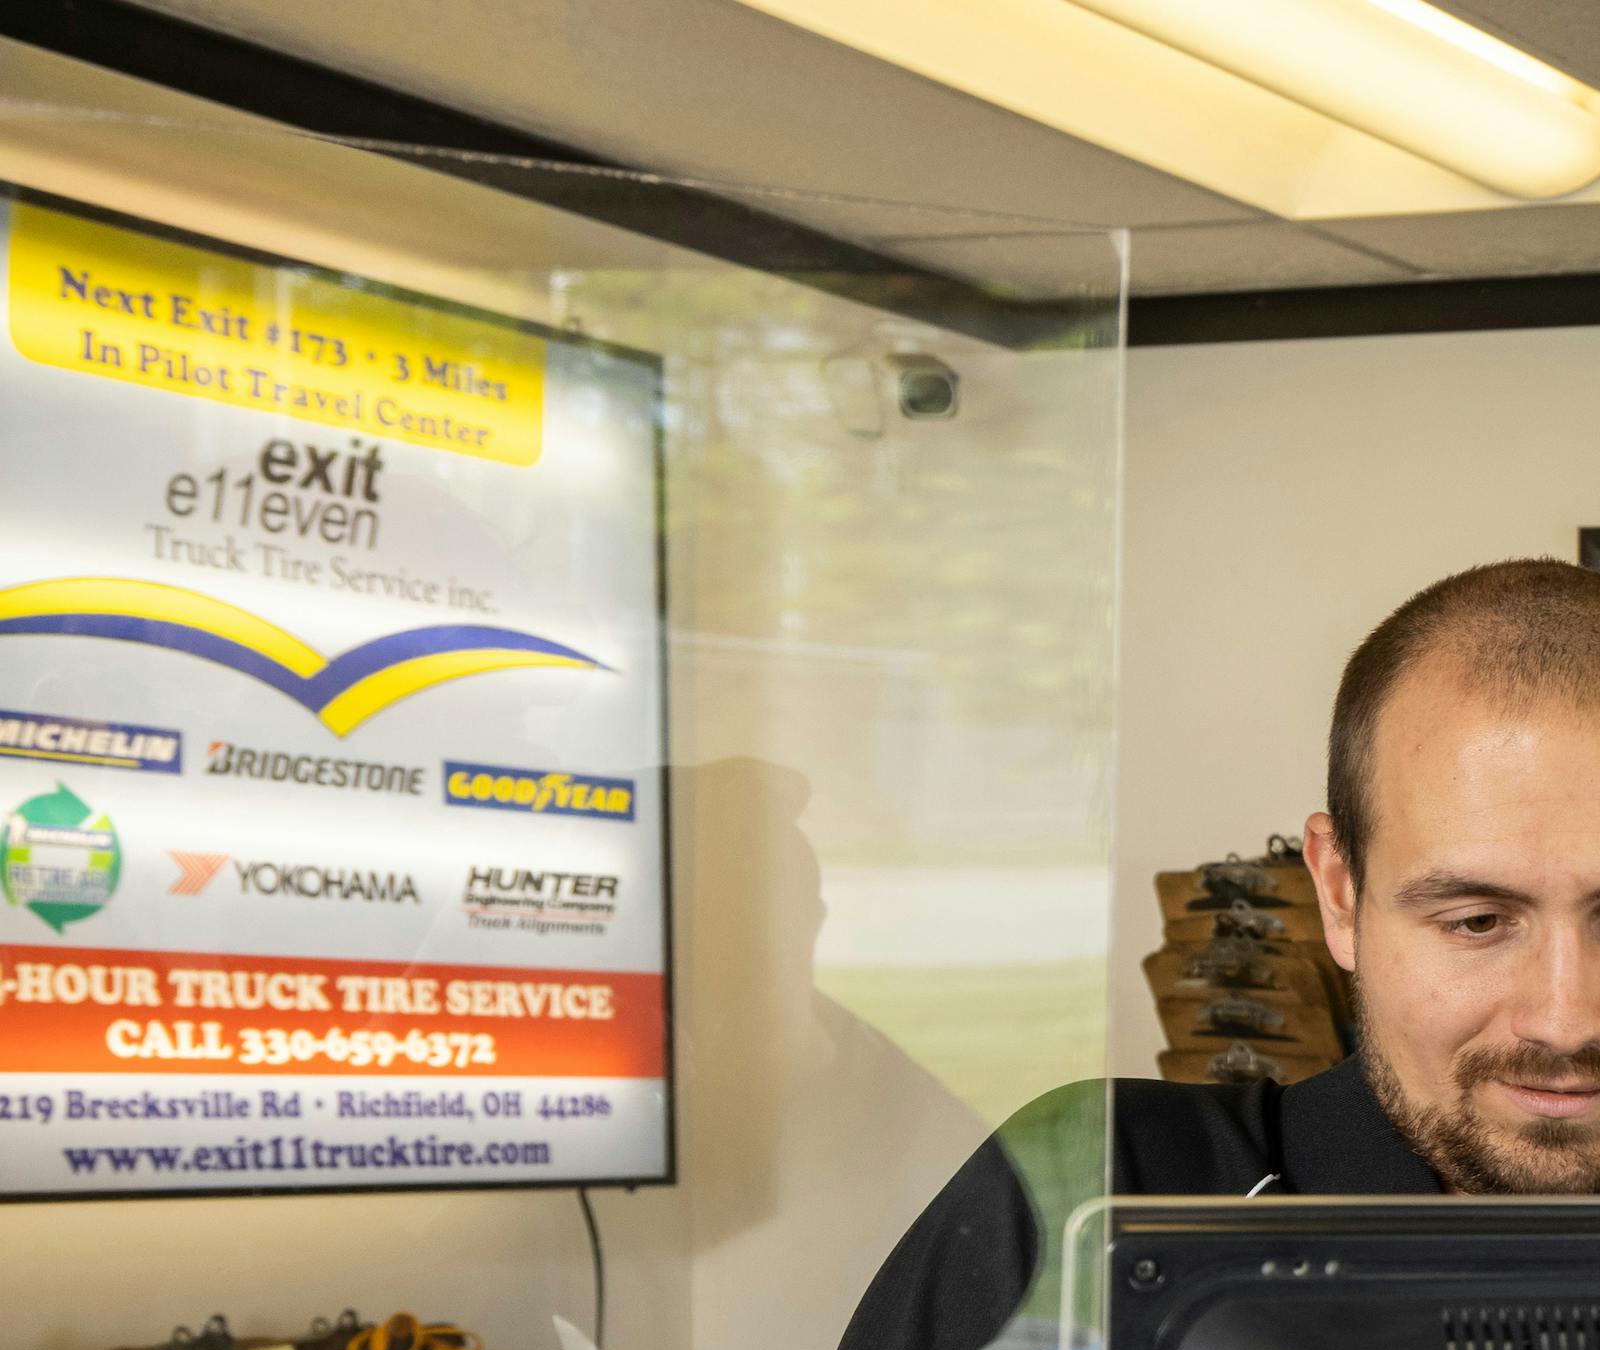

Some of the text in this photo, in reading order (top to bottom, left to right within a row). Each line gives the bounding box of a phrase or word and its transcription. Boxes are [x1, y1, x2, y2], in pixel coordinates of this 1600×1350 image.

[58, 265, 511, 403] Next Exit #173 3 Miles
[80, 330, 491, 449] In Pilot Travel Center
[258, 438, 386, 504] exit
[145, 523, 500, 616] Truck Tire Service inc.
[206, 741, 427, 795] BRIDGESTONE
[446, 769, 633, 816] GOODYEAR
[234, 860, 421, 904] YOKOHAMA
[467, 865, 620, 899] HUNTER
[0, 962, 617, 1021] -HOUR TRUCK TIRE SERVICE
[105, 1019, 498, 1068] CALL 330-659-6372
[64, 1090, 251, 1123] Brecksville
[260, 1089, 303, 1120] Rd
[336, 1090, 475, 1124] Richfield,
[481, 1092, 525, 1119] OH
[63, 1135, 552, 1175] www.exit11trucktire.com
